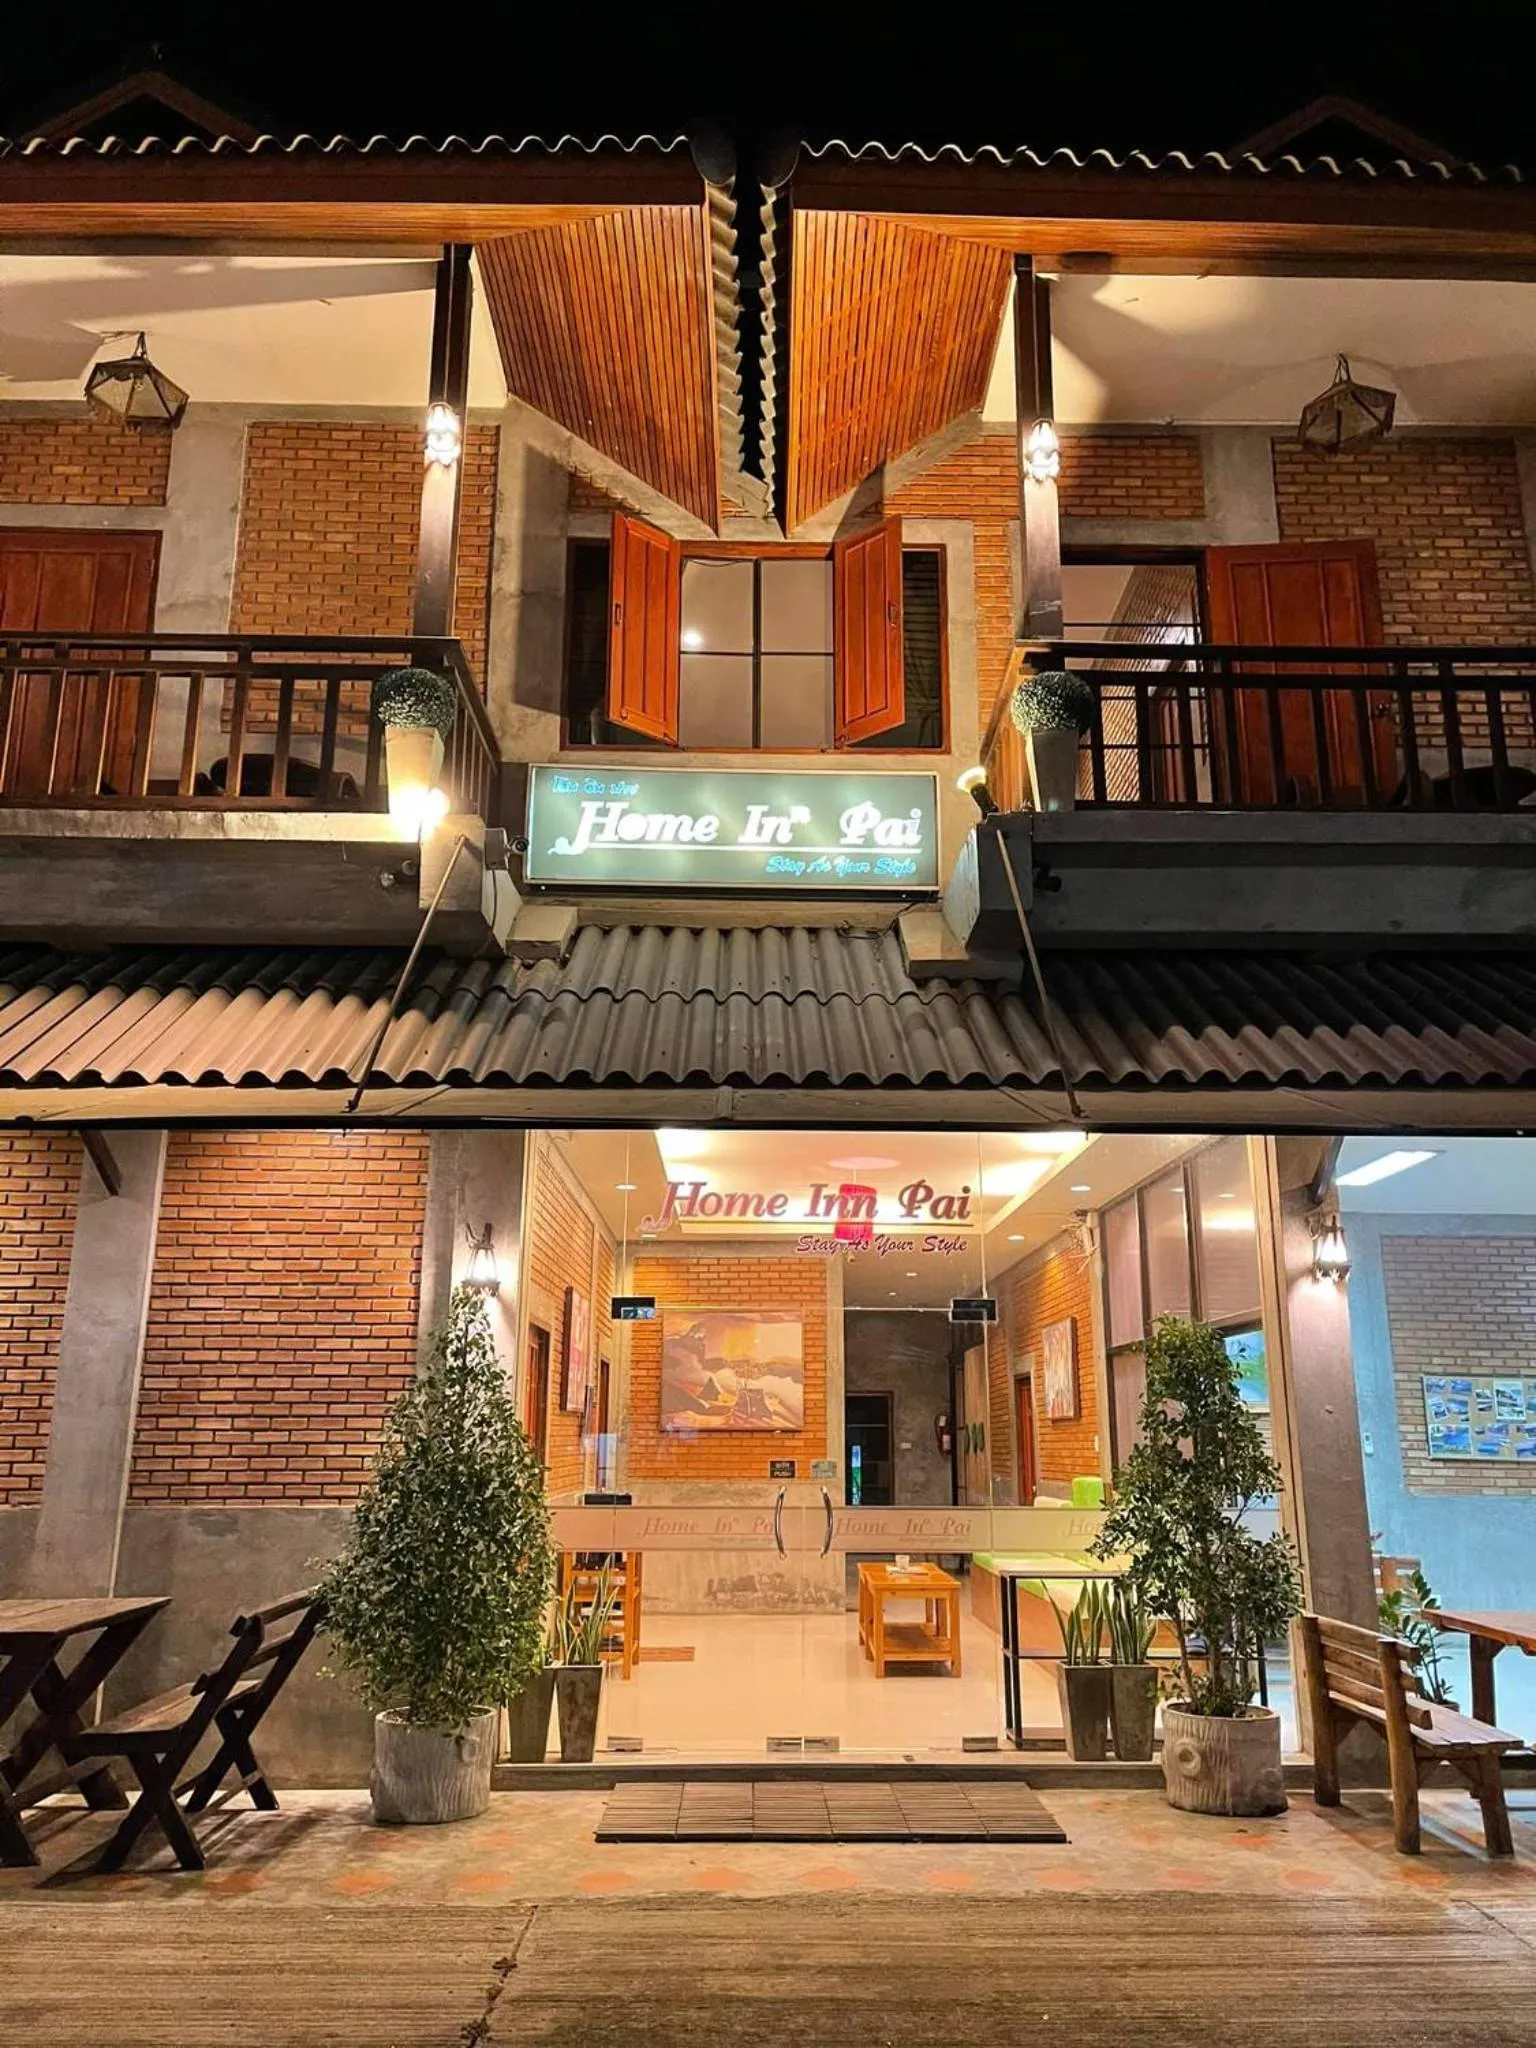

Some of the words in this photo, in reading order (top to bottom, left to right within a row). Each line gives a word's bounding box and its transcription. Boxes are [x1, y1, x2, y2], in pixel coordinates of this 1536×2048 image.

[548, 800, 720, 855] Home
[839, 800, 923, 846] Pai
[765, 855, 806, 877] Stay
[807, 855, 832, 873] As
[833, 855, 871, 877] Your
[874, 855, 917, 877] Style
[635, 1181, 789, 1232] Home
[803, 1182, 879, 1219] Inn
[898, 1179, 972, 1220] Pai
[797, 1234, 838, 1256] Stay
[845, 1233, 869, 1253] As
[873, 1232, 914, 1257] Your
[921, 1235, 968, 1257] Style
[636, 1516, 699, 1539] Home
[752, 1515, 774, 1534] Pa
[835, 1516, 888, 1536] Home
[941, 1514, 972, 1534] Pai
